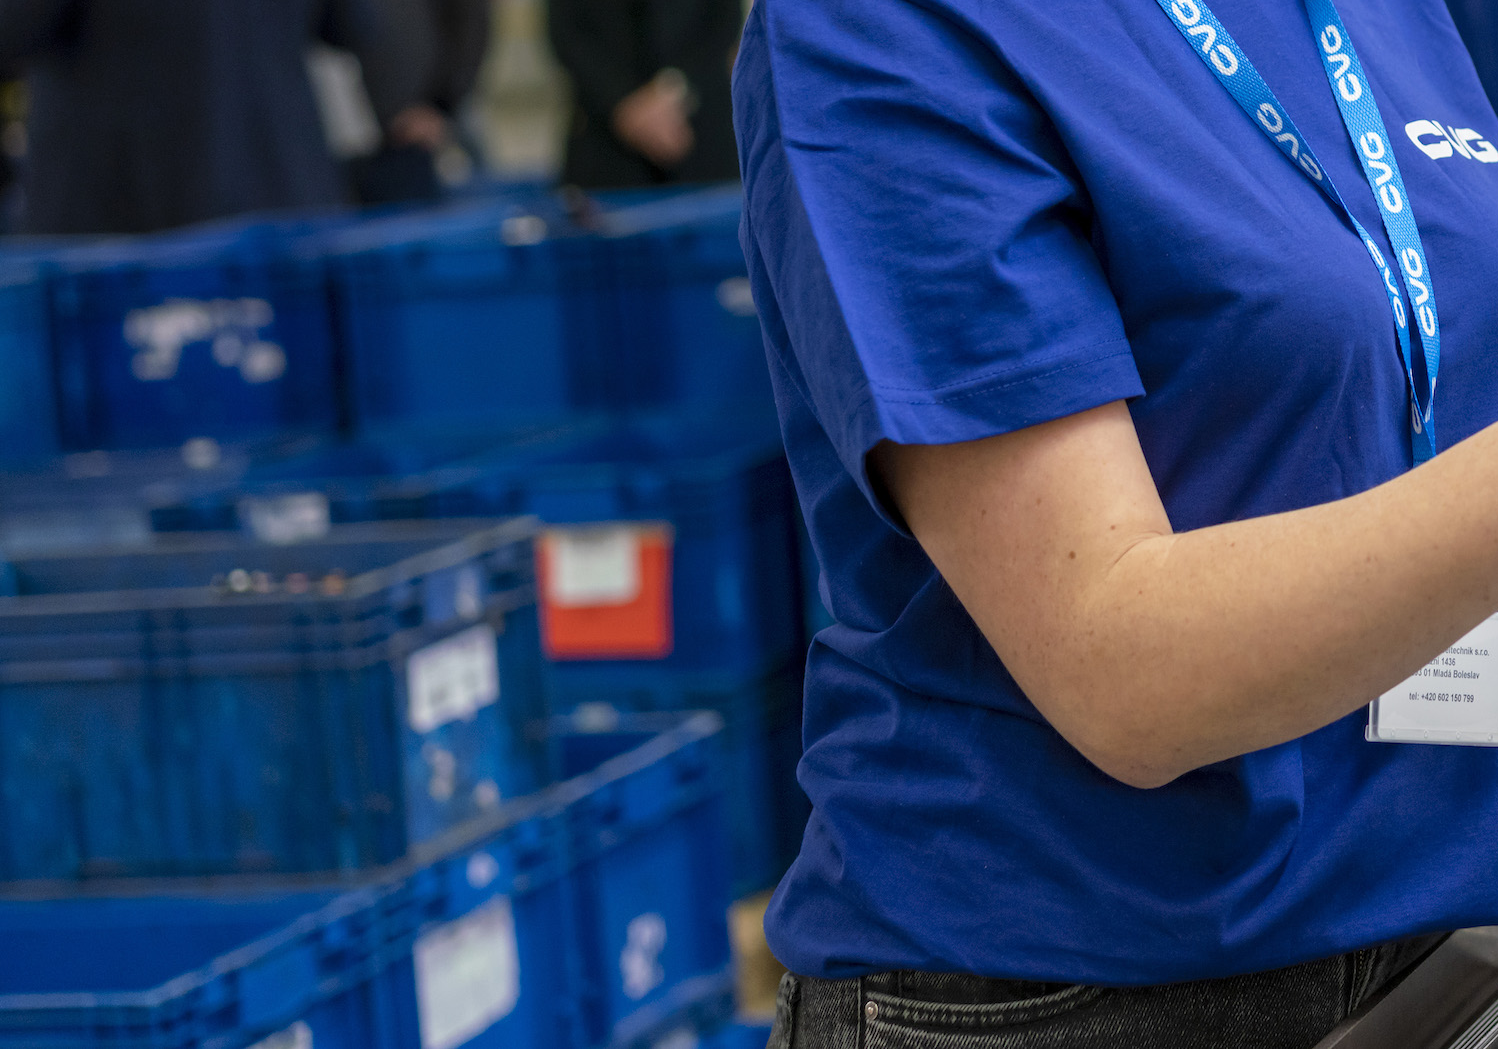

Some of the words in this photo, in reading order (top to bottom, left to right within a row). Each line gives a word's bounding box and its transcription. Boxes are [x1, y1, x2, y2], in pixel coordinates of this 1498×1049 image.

[1320, 24, 1363, 102] CVG
[1360, 131, 1403, 214] CVG
[1401, 247, 1436, 337] CVG
[1423, 668, 1431, 677] 01
[1453, 669, 1480, 680] Boleslav
[1441, 657, 1456, 666] 1436
[1409, 693, 1420, 701] tel:
[1421, 692, 1437, 701] +420
[1437, 693, 1450, 702] 602
[1450, 693, 1462, 703] 150
[1462, 694, 1475, 703] 799
